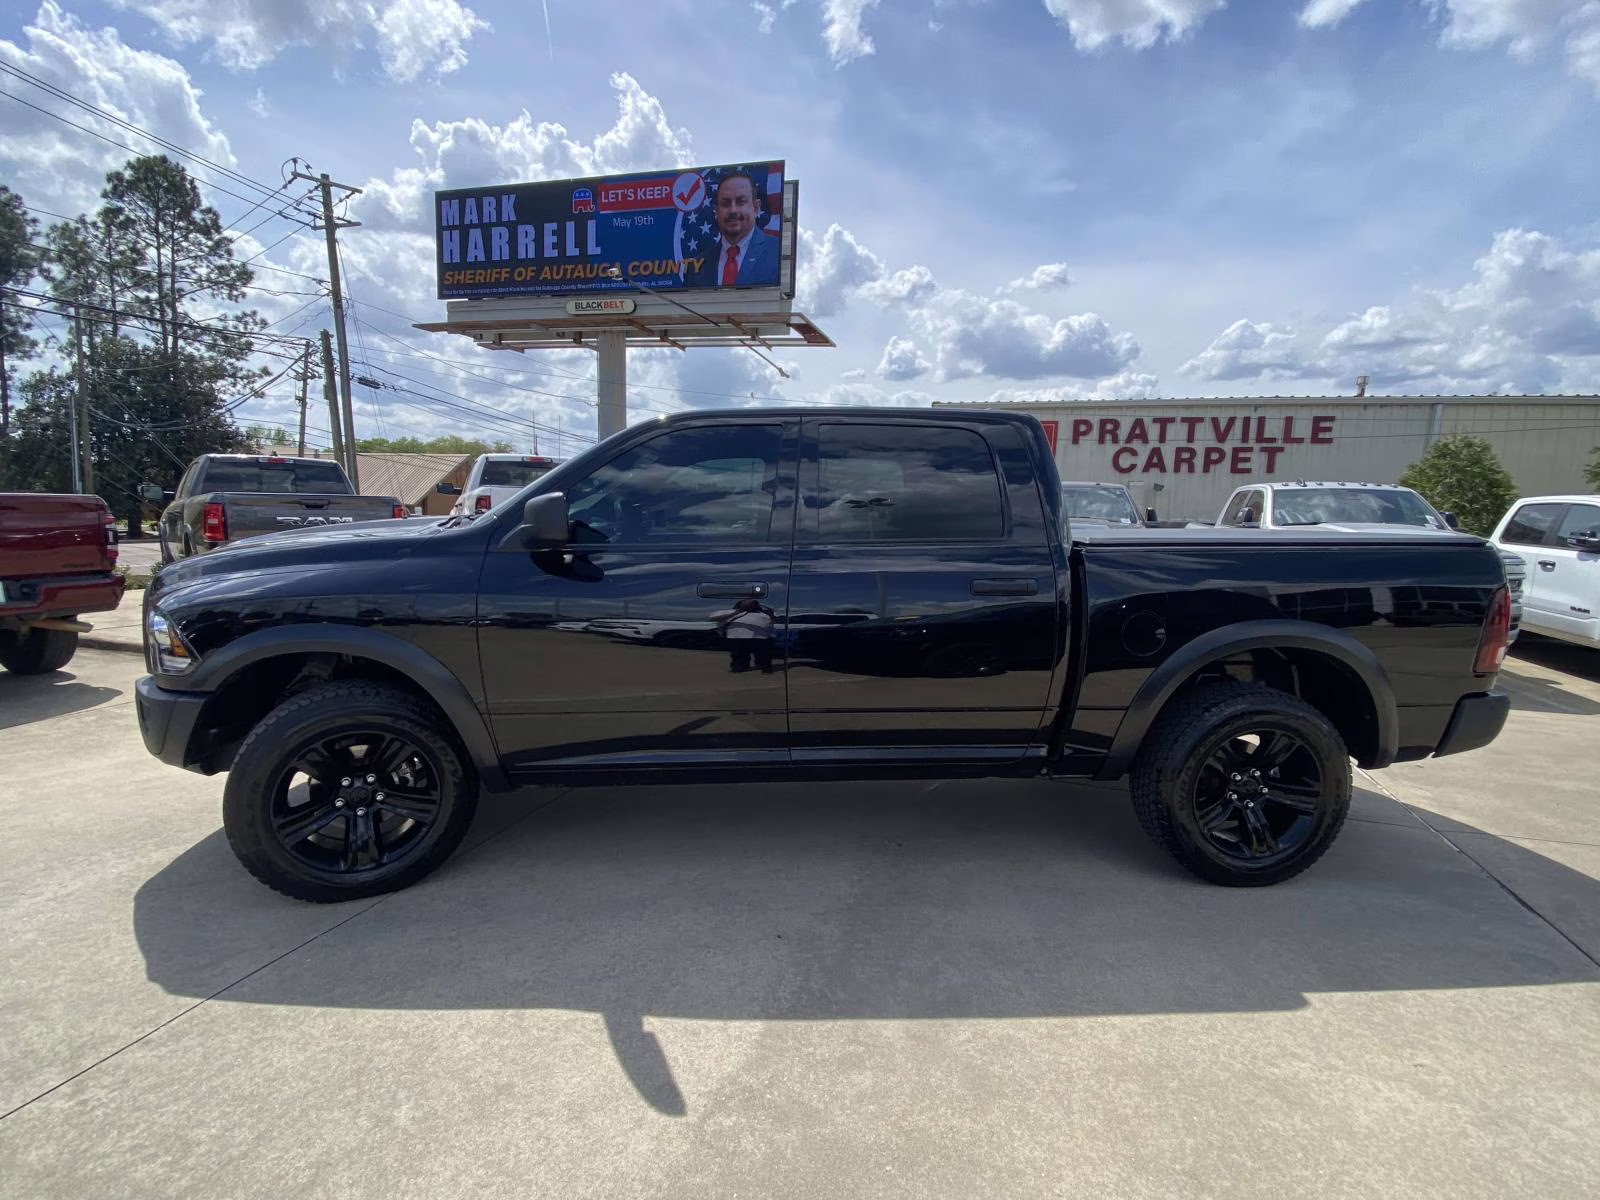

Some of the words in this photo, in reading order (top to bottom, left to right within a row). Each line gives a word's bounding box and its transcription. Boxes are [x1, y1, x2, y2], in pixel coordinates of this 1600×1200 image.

[601, 188, 635, 203] LET'S
[637, 185, 671, 200] KEEP
[441, 194, 517, 226] MARK
[612, 217, 631, 228] May
[633, 215, 654, 226] 19th
[442, 219, 602, 264] HARRELL
[443, 268, 511, 285] SHERIFF
[514, 266, 537, 281] OF
[628, 257, 706, 277] COUNTY
[575, 301, 625, 310] BLACKBELT
[1072, 415, 1336, 445] PRATTVILLE
[1112, 446, 1285, 474] CARPET
